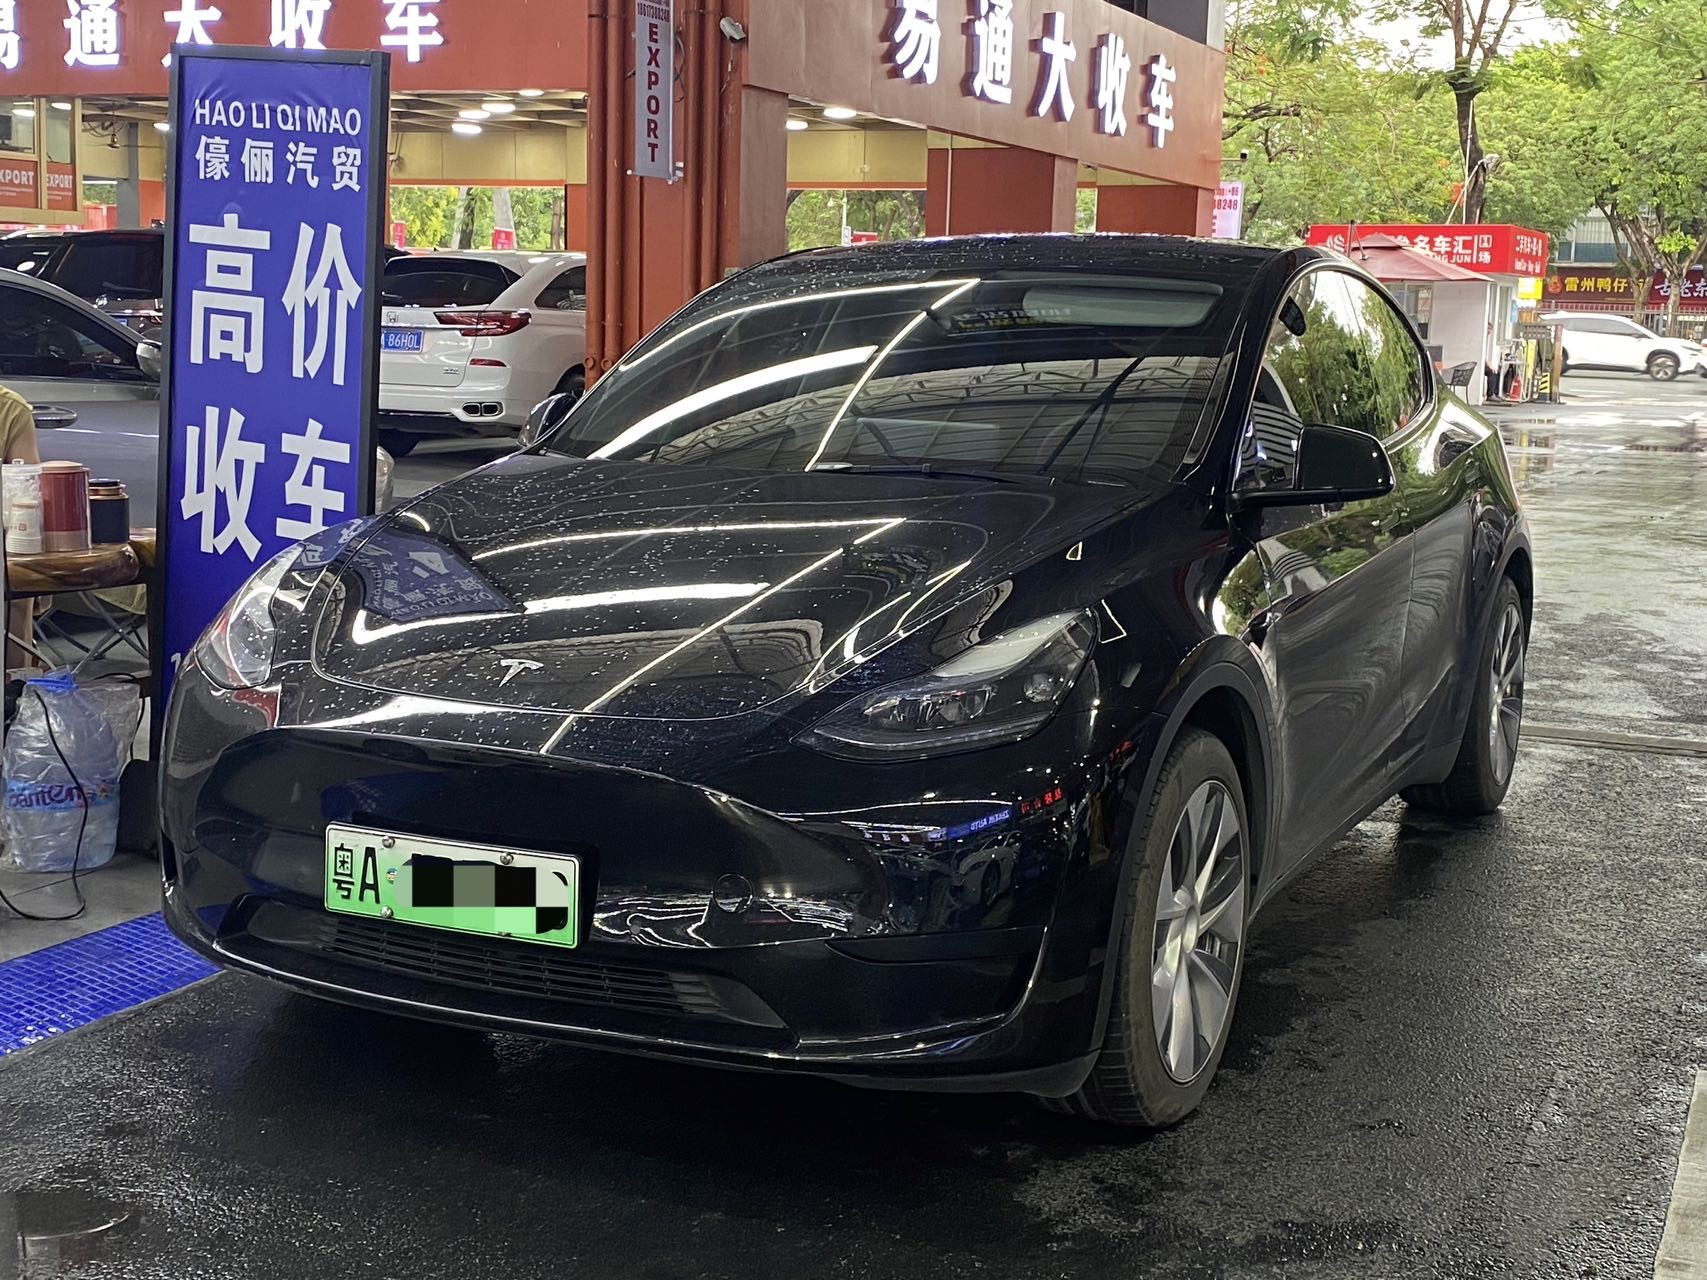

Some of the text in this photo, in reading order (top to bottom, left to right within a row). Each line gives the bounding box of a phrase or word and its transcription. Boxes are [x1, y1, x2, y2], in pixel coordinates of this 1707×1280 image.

[194, 98, 362, 136] HAO LI QI MAO
[646, 22, 661, 164] EXPORT
[1391, 234, 1472, 255] 名车汇
[188, 213, 362, 386] 高价
[1564, 276, 1646, 293] 雷州鸭仔
[180, 407, 351, 562] 收车
[332, 842, 381, 905] 粤A
